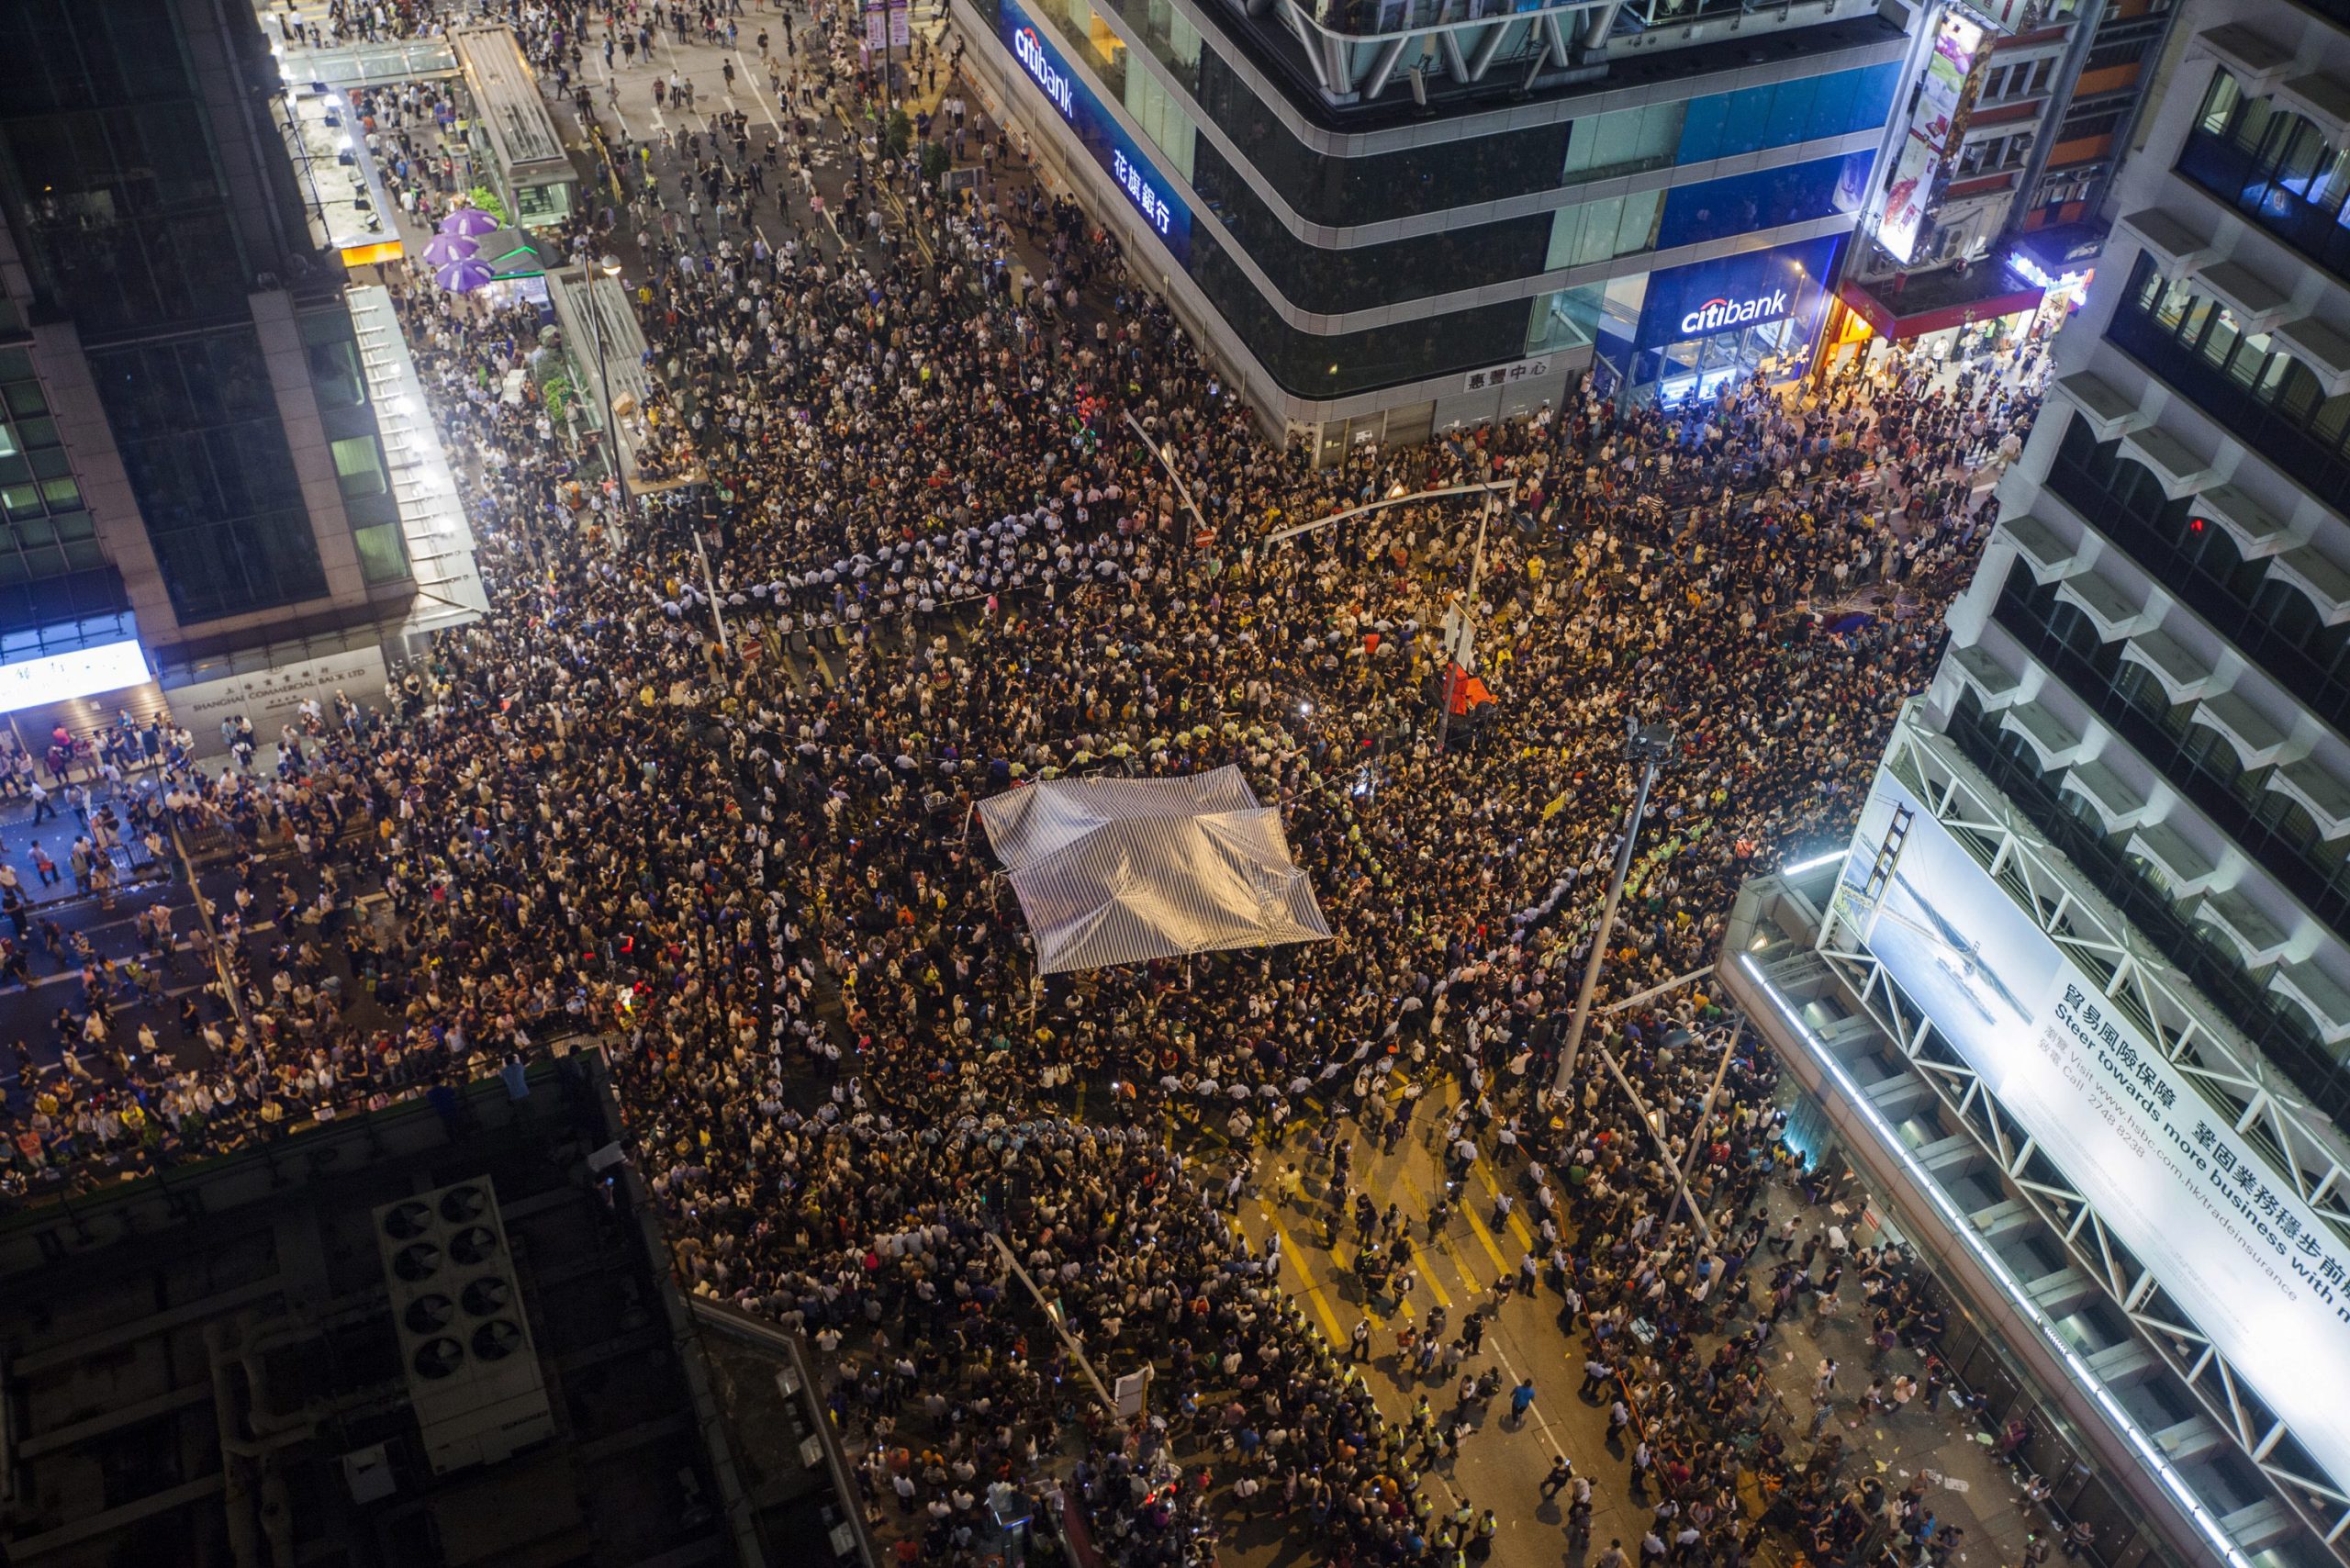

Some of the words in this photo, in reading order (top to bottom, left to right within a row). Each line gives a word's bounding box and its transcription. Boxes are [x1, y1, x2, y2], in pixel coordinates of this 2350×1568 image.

[1015, 27, 1073, 118] citibank
[1113, 149, 1170, 234] 花旗銀行
[1681, 288, 1787, 333] citibank
[193, 694, 246, 712] SHANGHAI
[249, 679, 316, 700] COMMERCIAL
[348, 668, 365, 678] LTD
[2063, 983, 2177, 1111] 貿易風險保障
[2054, 1003, 2096, 1049] Steer
[2098, 1049, 2161, 1122] towards
[2163, 1122, 2207, 1171] more
[2209, 1169, 2288, 1256] business
[2290, 1256, 2333, 1305] with
[2062, 1066, 2085, 1092] Call
[2087, 1093, 2116, 1126] 2748
[2116, 1125, 2146, 1159] 8238
[2070, 1050, 2094, 1083] Visit
[2096, 1081, 2298, 1302] www.hsbc.com.hk/tradeinsurance
